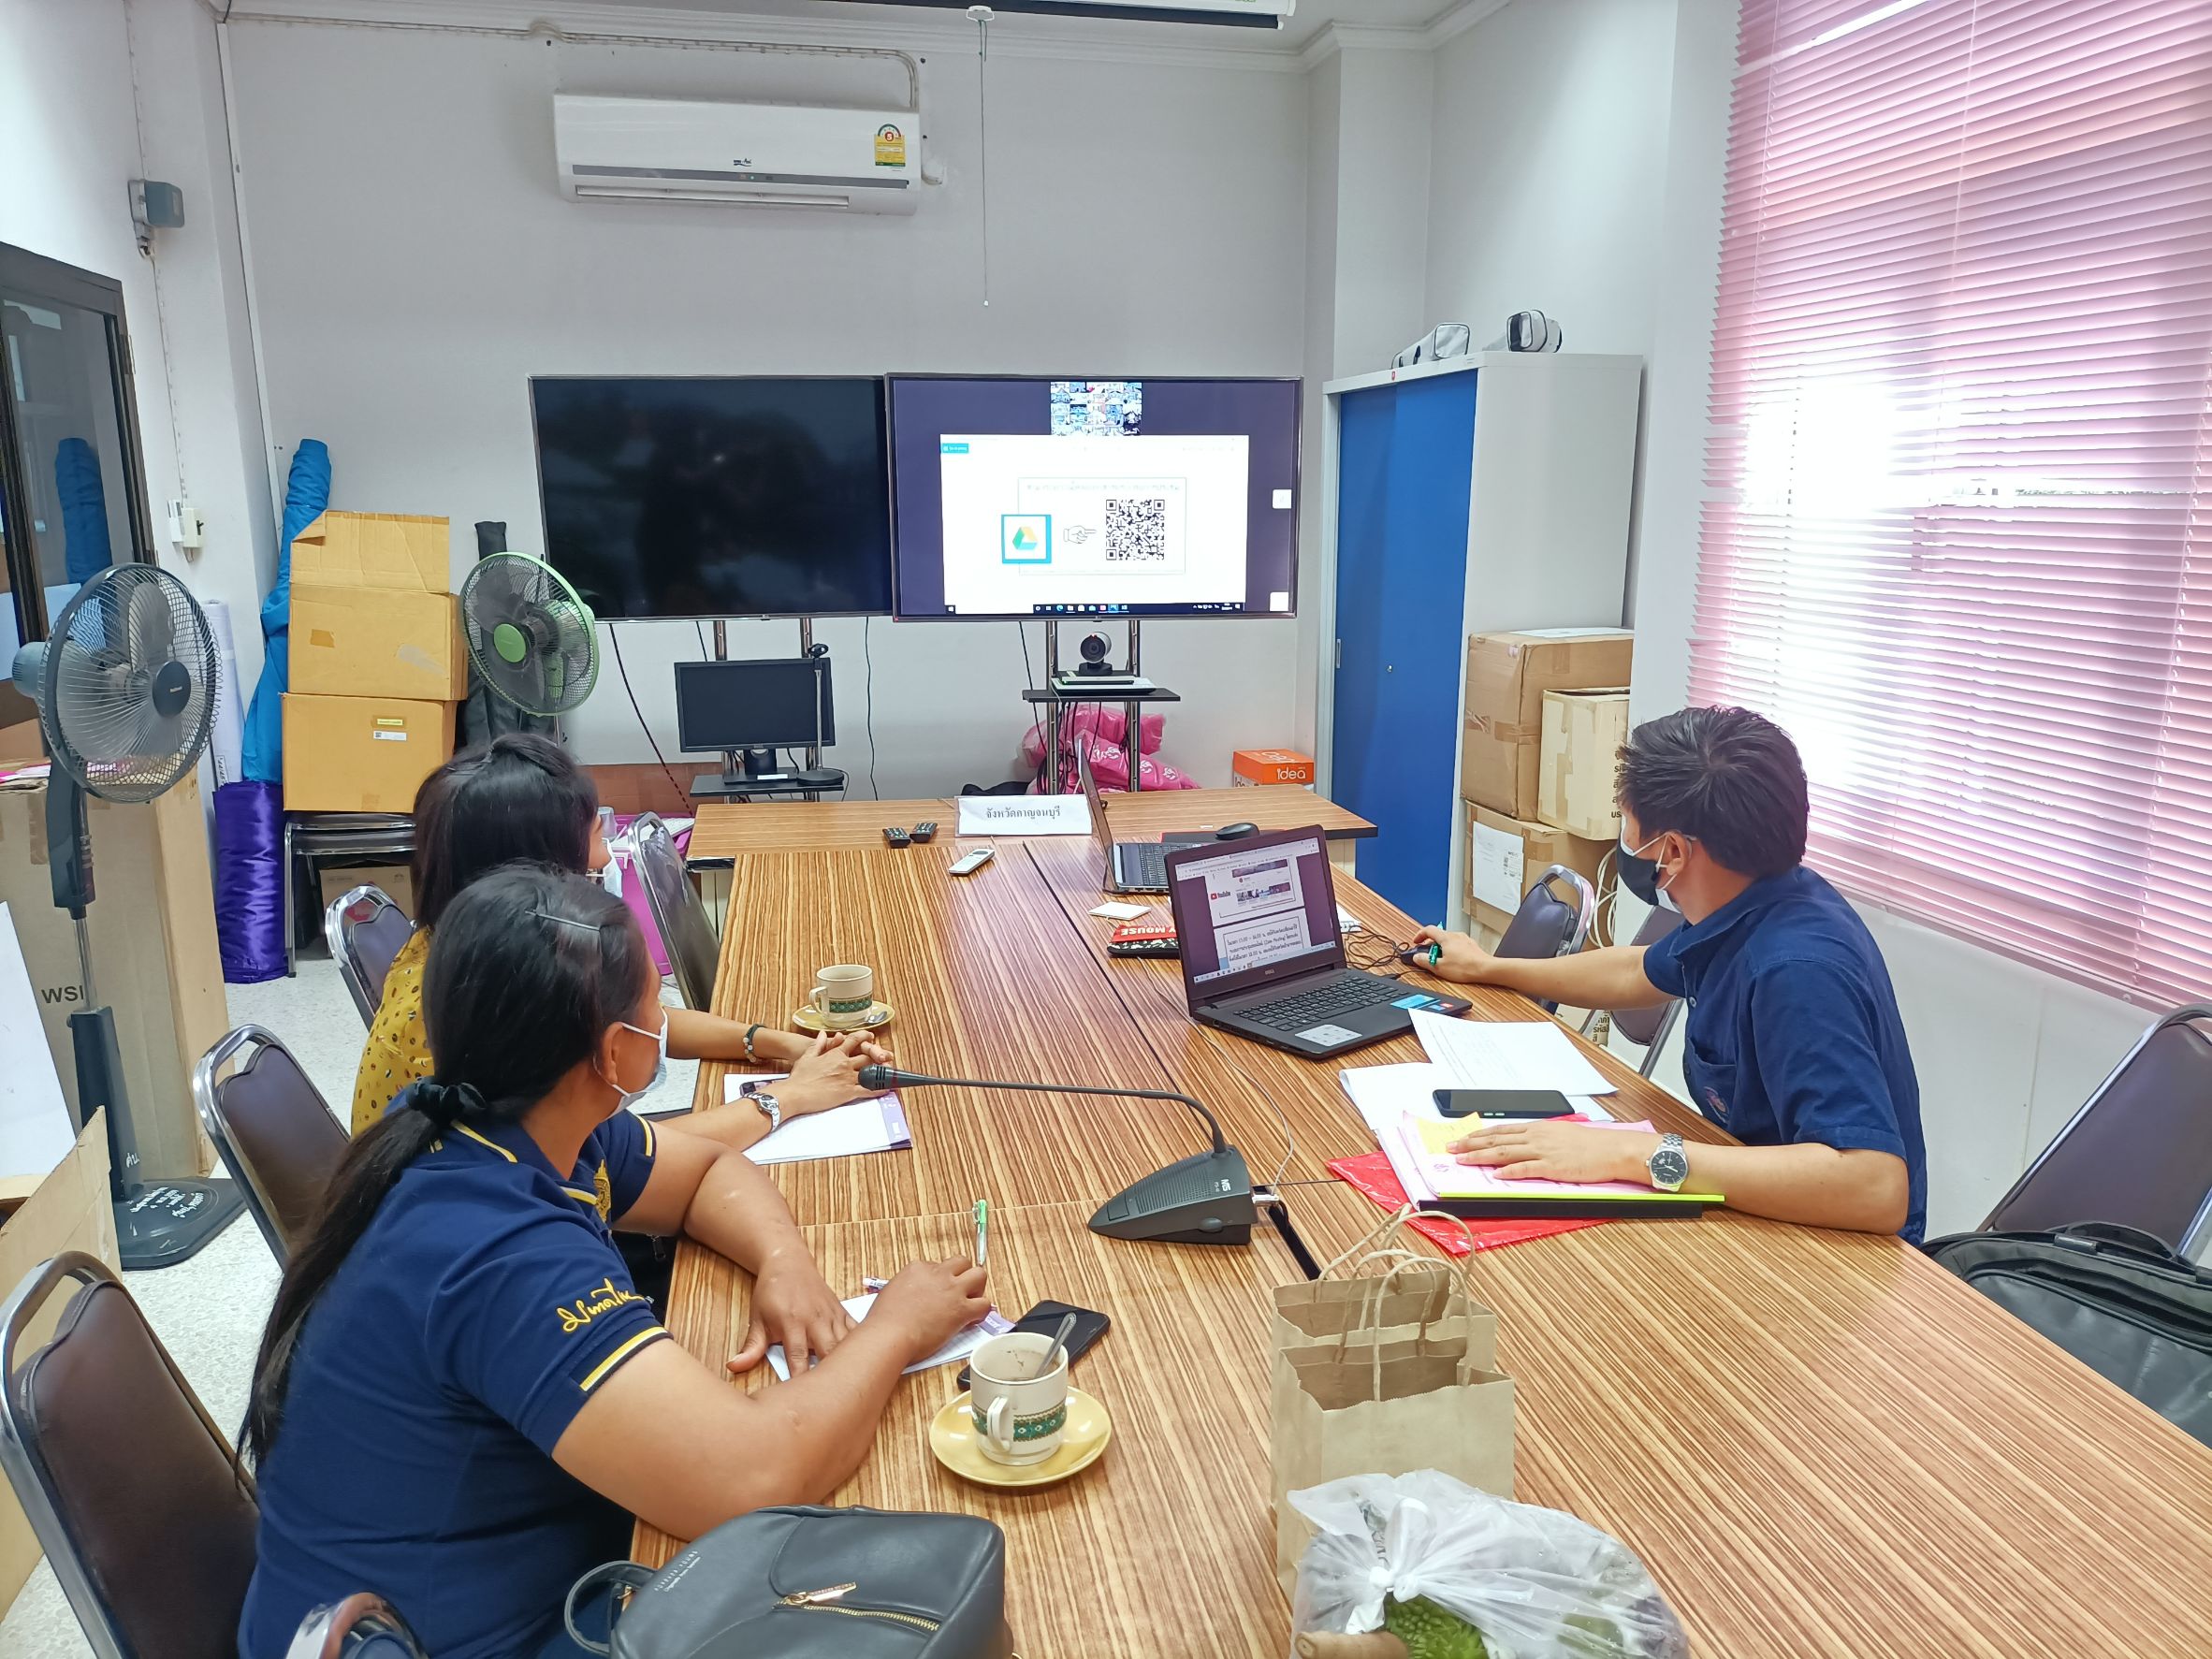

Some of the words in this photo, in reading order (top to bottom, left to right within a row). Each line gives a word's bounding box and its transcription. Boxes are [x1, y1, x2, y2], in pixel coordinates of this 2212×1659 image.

[986, 806, 1061, 820] จังหวัดกาญจนบุรี
[1121, 926, 1165, 936] MOUSE
